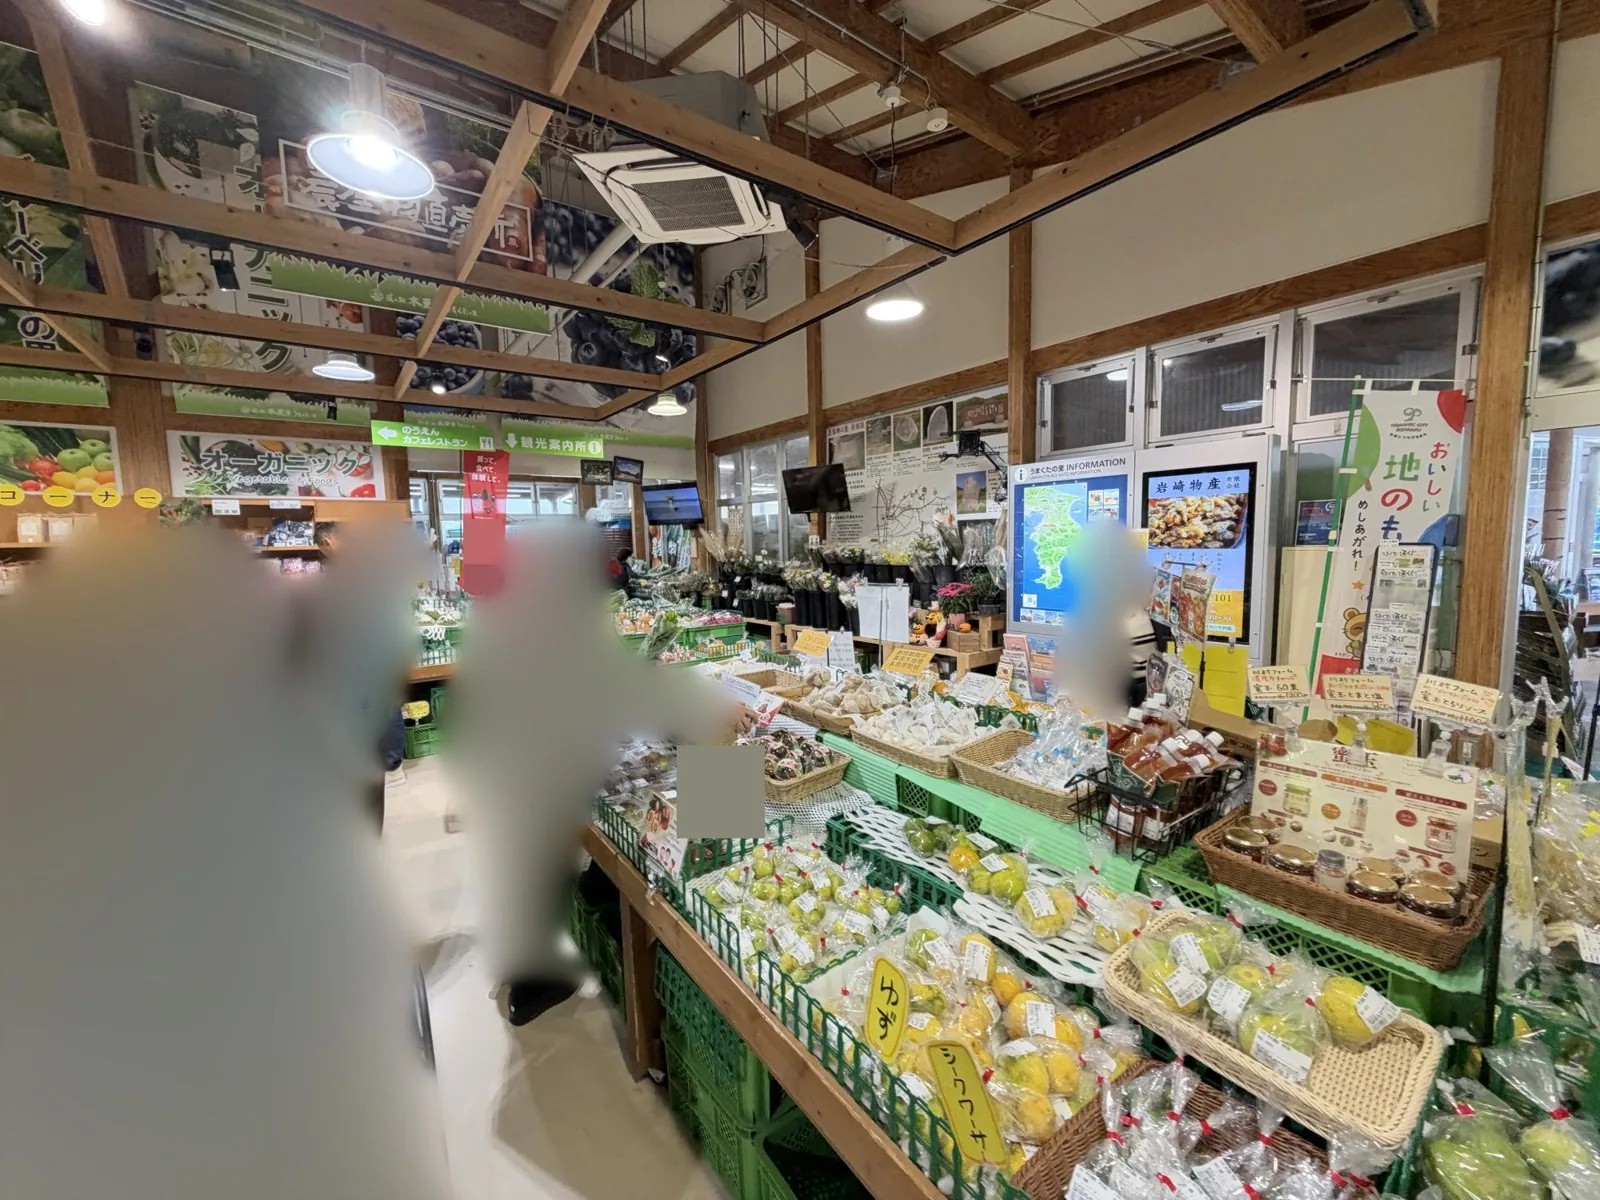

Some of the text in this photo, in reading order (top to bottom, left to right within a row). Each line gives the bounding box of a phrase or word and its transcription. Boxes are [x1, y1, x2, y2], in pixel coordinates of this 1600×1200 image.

[402, 426, 440, 436] のうえん
[402, 435, 468, 448] カフェレストラン
[521, 436, 587, 452] 観光案内所
[201, 450, 359, 475] オーガニック
[1030, 457, 1126, 476] うまくたの里 INFORMATION
[228, 473, 293, 488] Vegetables
[1422, 442, 1450, 512] おいしい
[1156, 478, 1221, 493] 岩崎物産
[877, 975, 899, 1040] ゆず
